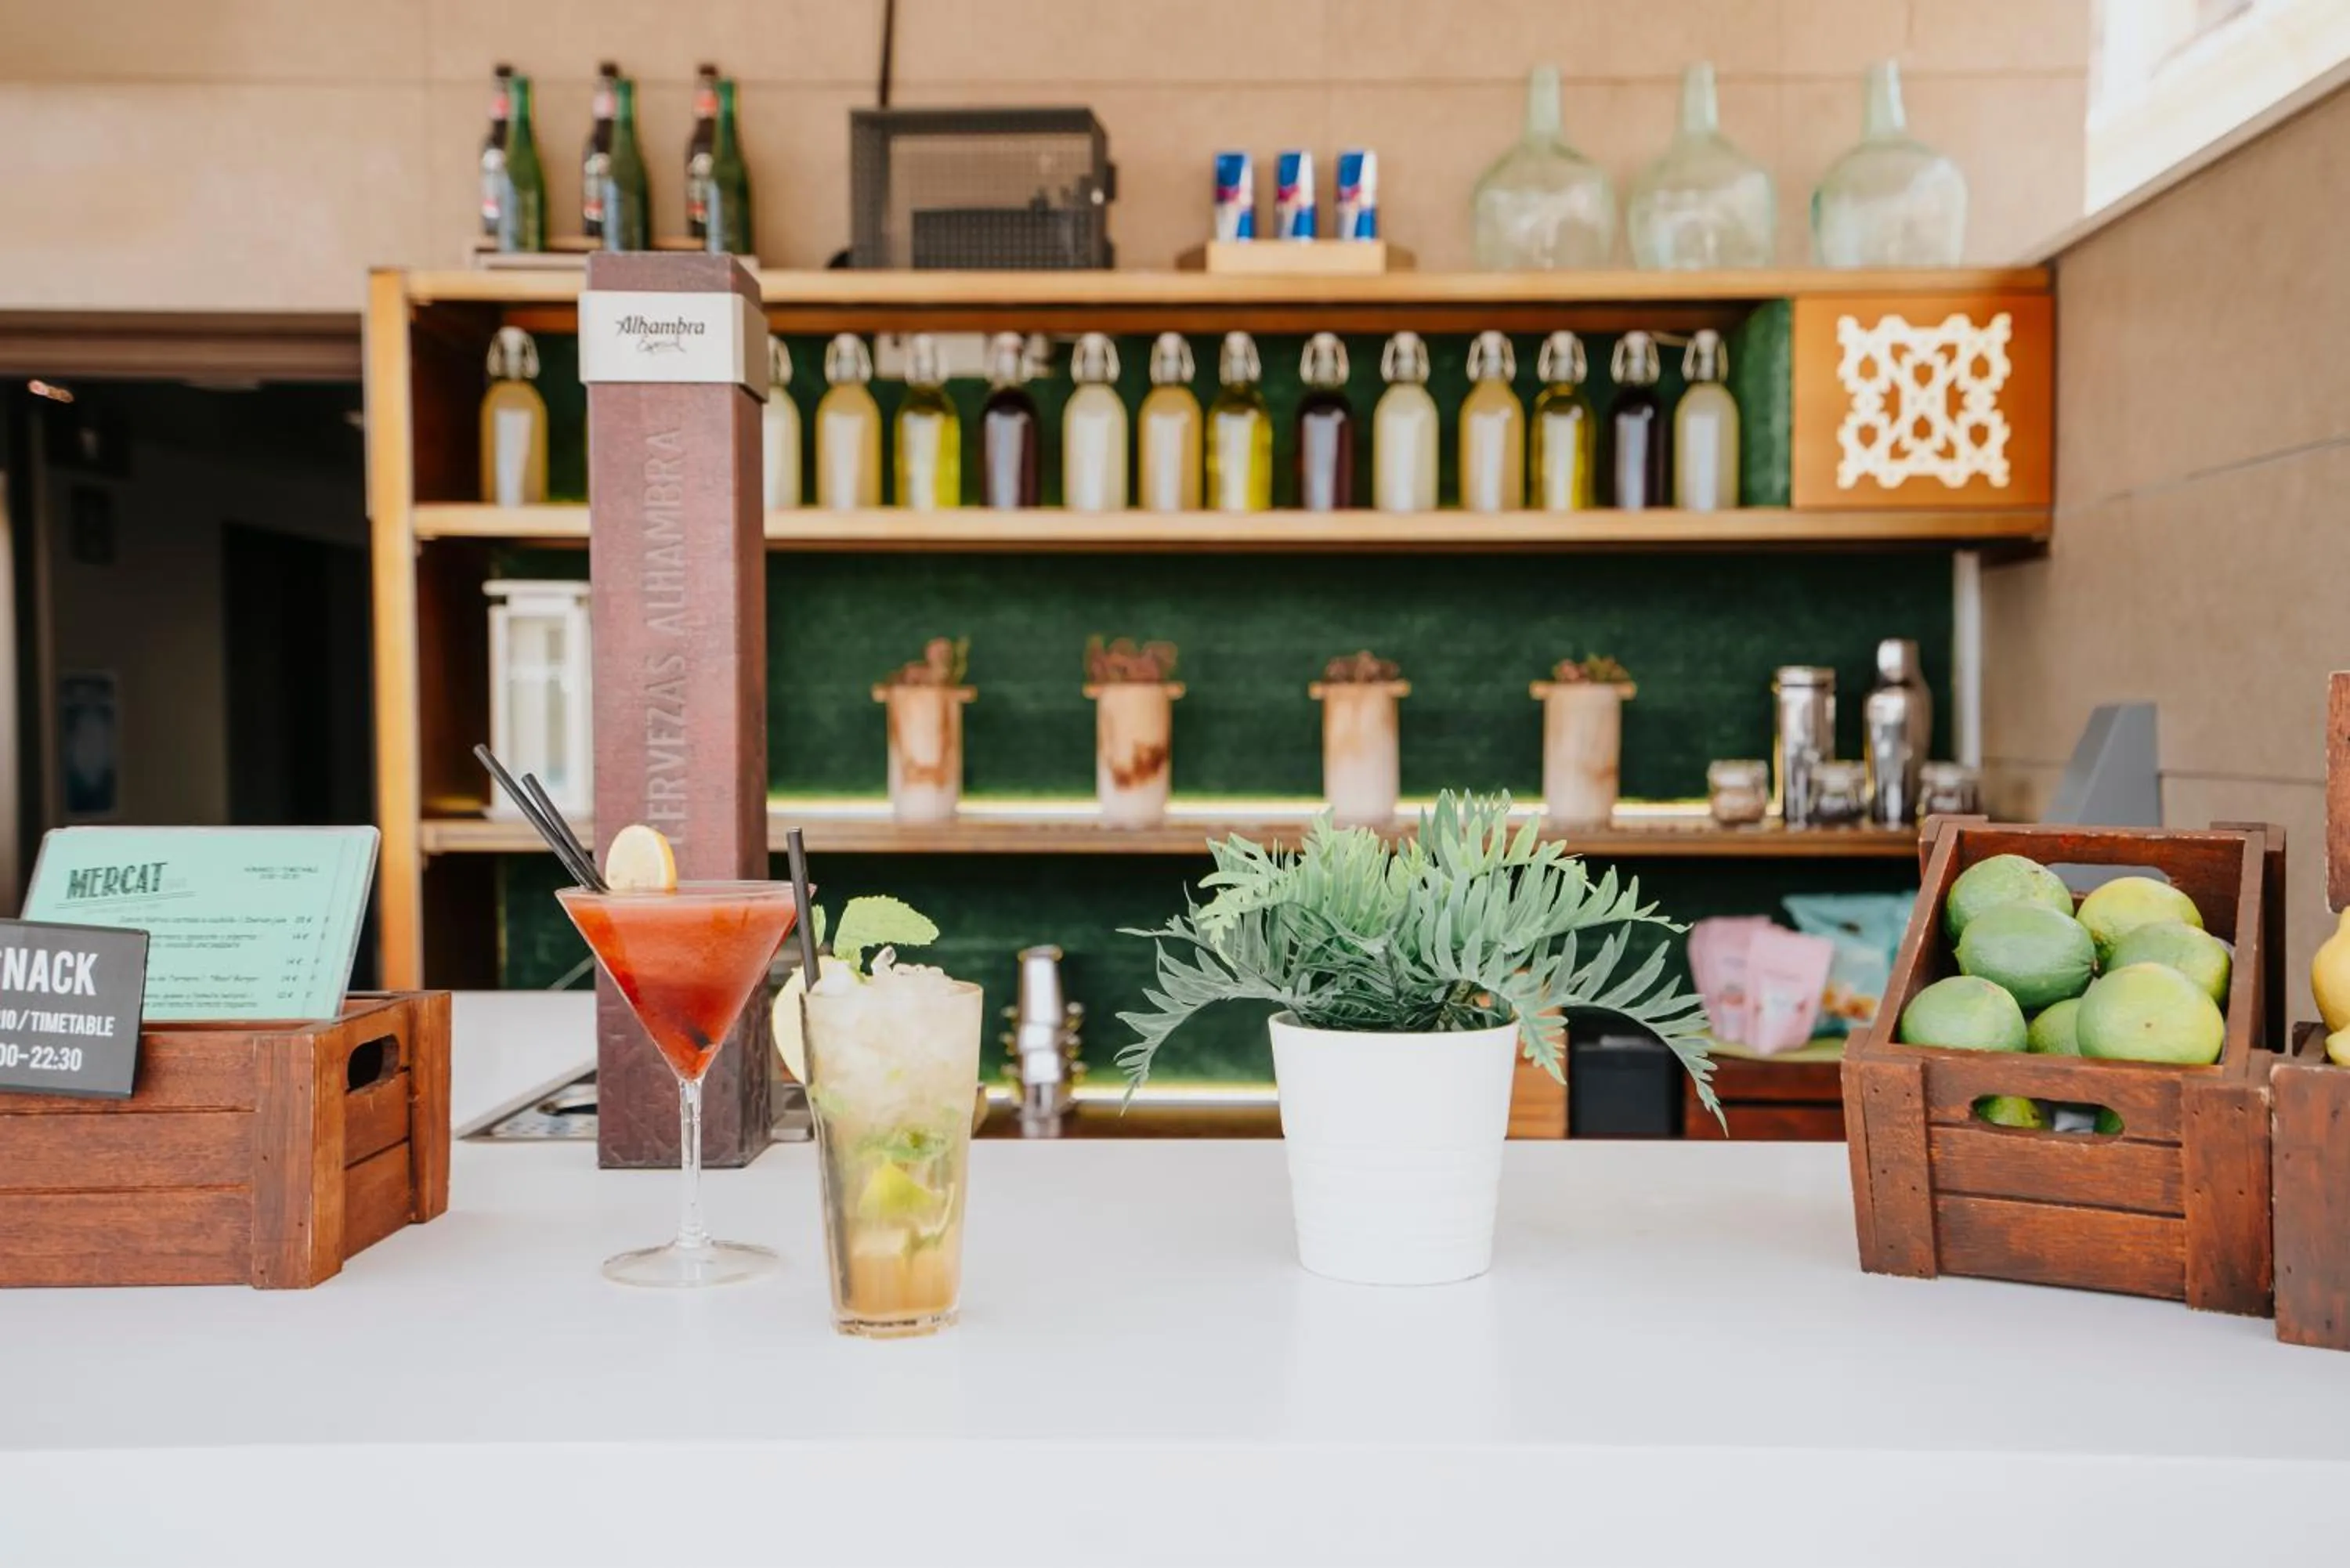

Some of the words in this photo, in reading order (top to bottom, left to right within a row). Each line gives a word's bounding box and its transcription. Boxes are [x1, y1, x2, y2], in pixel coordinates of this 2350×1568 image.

[615, 315, 705, 335] Alhambra
[643, 430, 685, 636] ALHAMBRA
[67, 862, 168, 899] MERCAT
[0, 947, 99, 995] NACK
